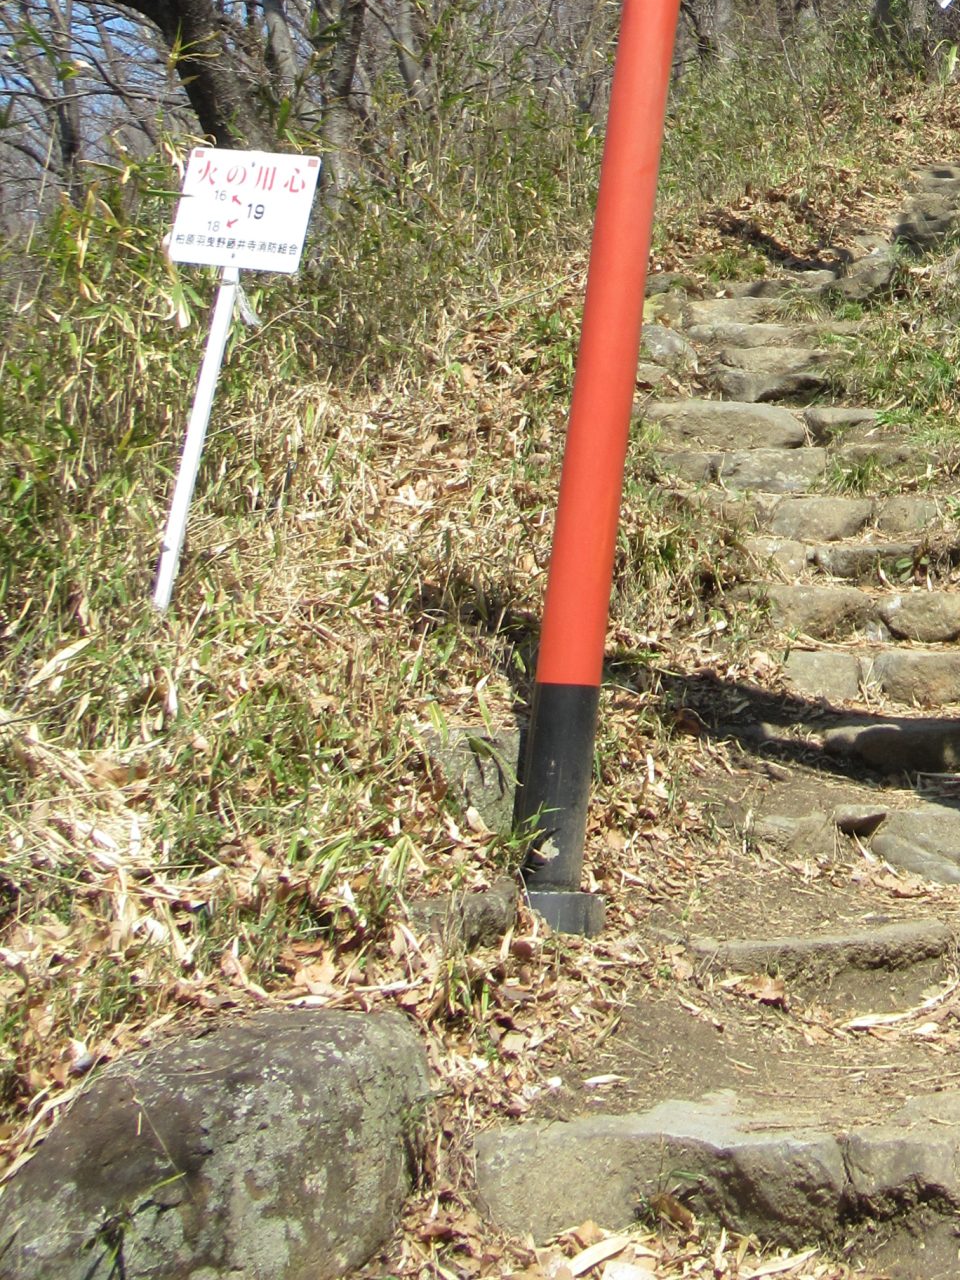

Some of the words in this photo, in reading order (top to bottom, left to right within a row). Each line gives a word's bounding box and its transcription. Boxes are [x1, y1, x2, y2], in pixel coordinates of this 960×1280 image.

[214, 189, 227, 201] 16
[247, 203, 265, 220] 19
[207, 220, 220, 232] 18
